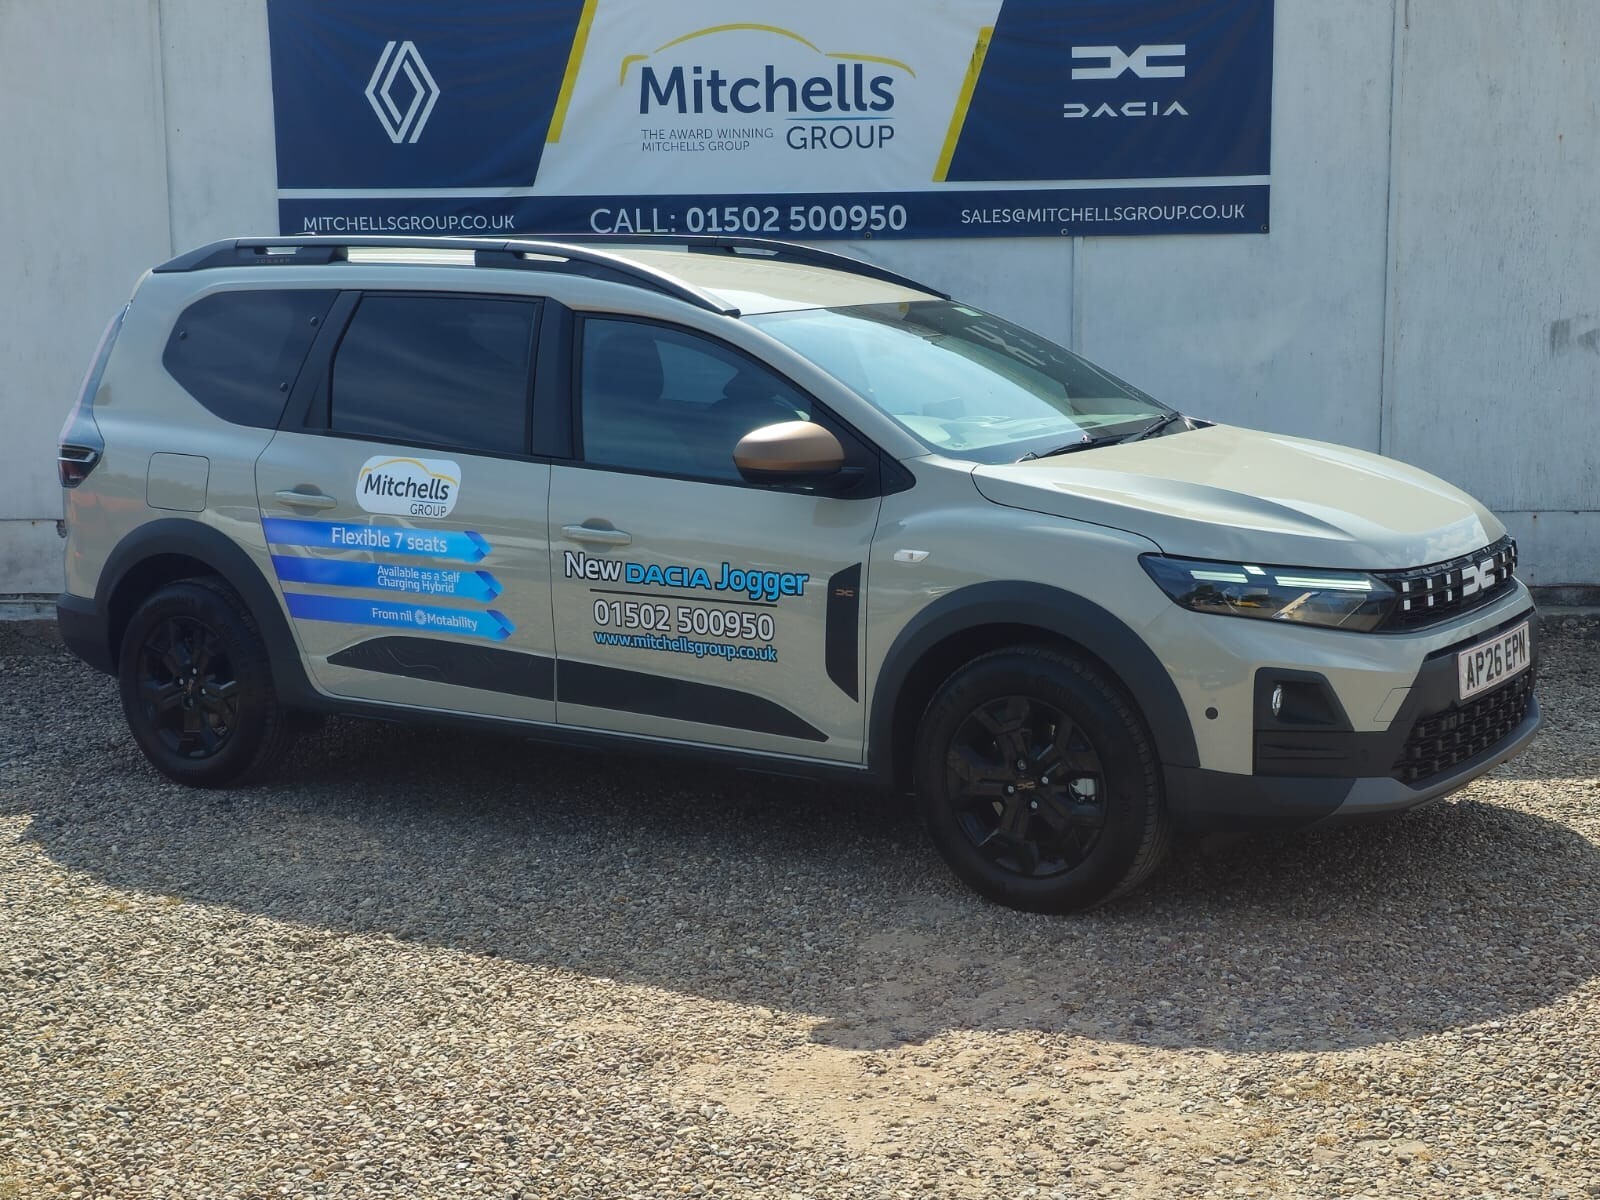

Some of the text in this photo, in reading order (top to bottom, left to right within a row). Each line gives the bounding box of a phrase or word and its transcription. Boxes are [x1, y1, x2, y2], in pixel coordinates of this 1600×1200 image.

[640, 64, 894, 115] Mitchells
[1063, 101, 1189, 118] DACIA
[641, 127, 774, 140] THE AWARD WINNING
[786, 125, 894, 150] GROUP
[642, 140, 750, 152] MITCHELLS GROUP
[303, 214, 515, 232] MITCHELLSGROUP.CO.UK
[590, 205, 907, 234] CALL: 01502 500950
[961, 204, 1246, 224] SALES@MITCHELLSGROUP.CO.UK
[363, 474, 450, 501] Mitchells
[410, 503, 447, 517] GROUP
[331, 527, 448, 553] Flexible 7 seats
[377, 565, 461, 583] Available as a Self
[377, 576, 455, 595] Charging Hybrid
[564, 551, 809, 601] New DACIA Jogger
[372, 607, 478, 631] From nil Motability
[593, 600, 775, 641] 01502 500950
[593, 631, 778, 662] www.mitchellsgroup.co.uk
[1467, 628, 1526, 690] AP26 EPN
